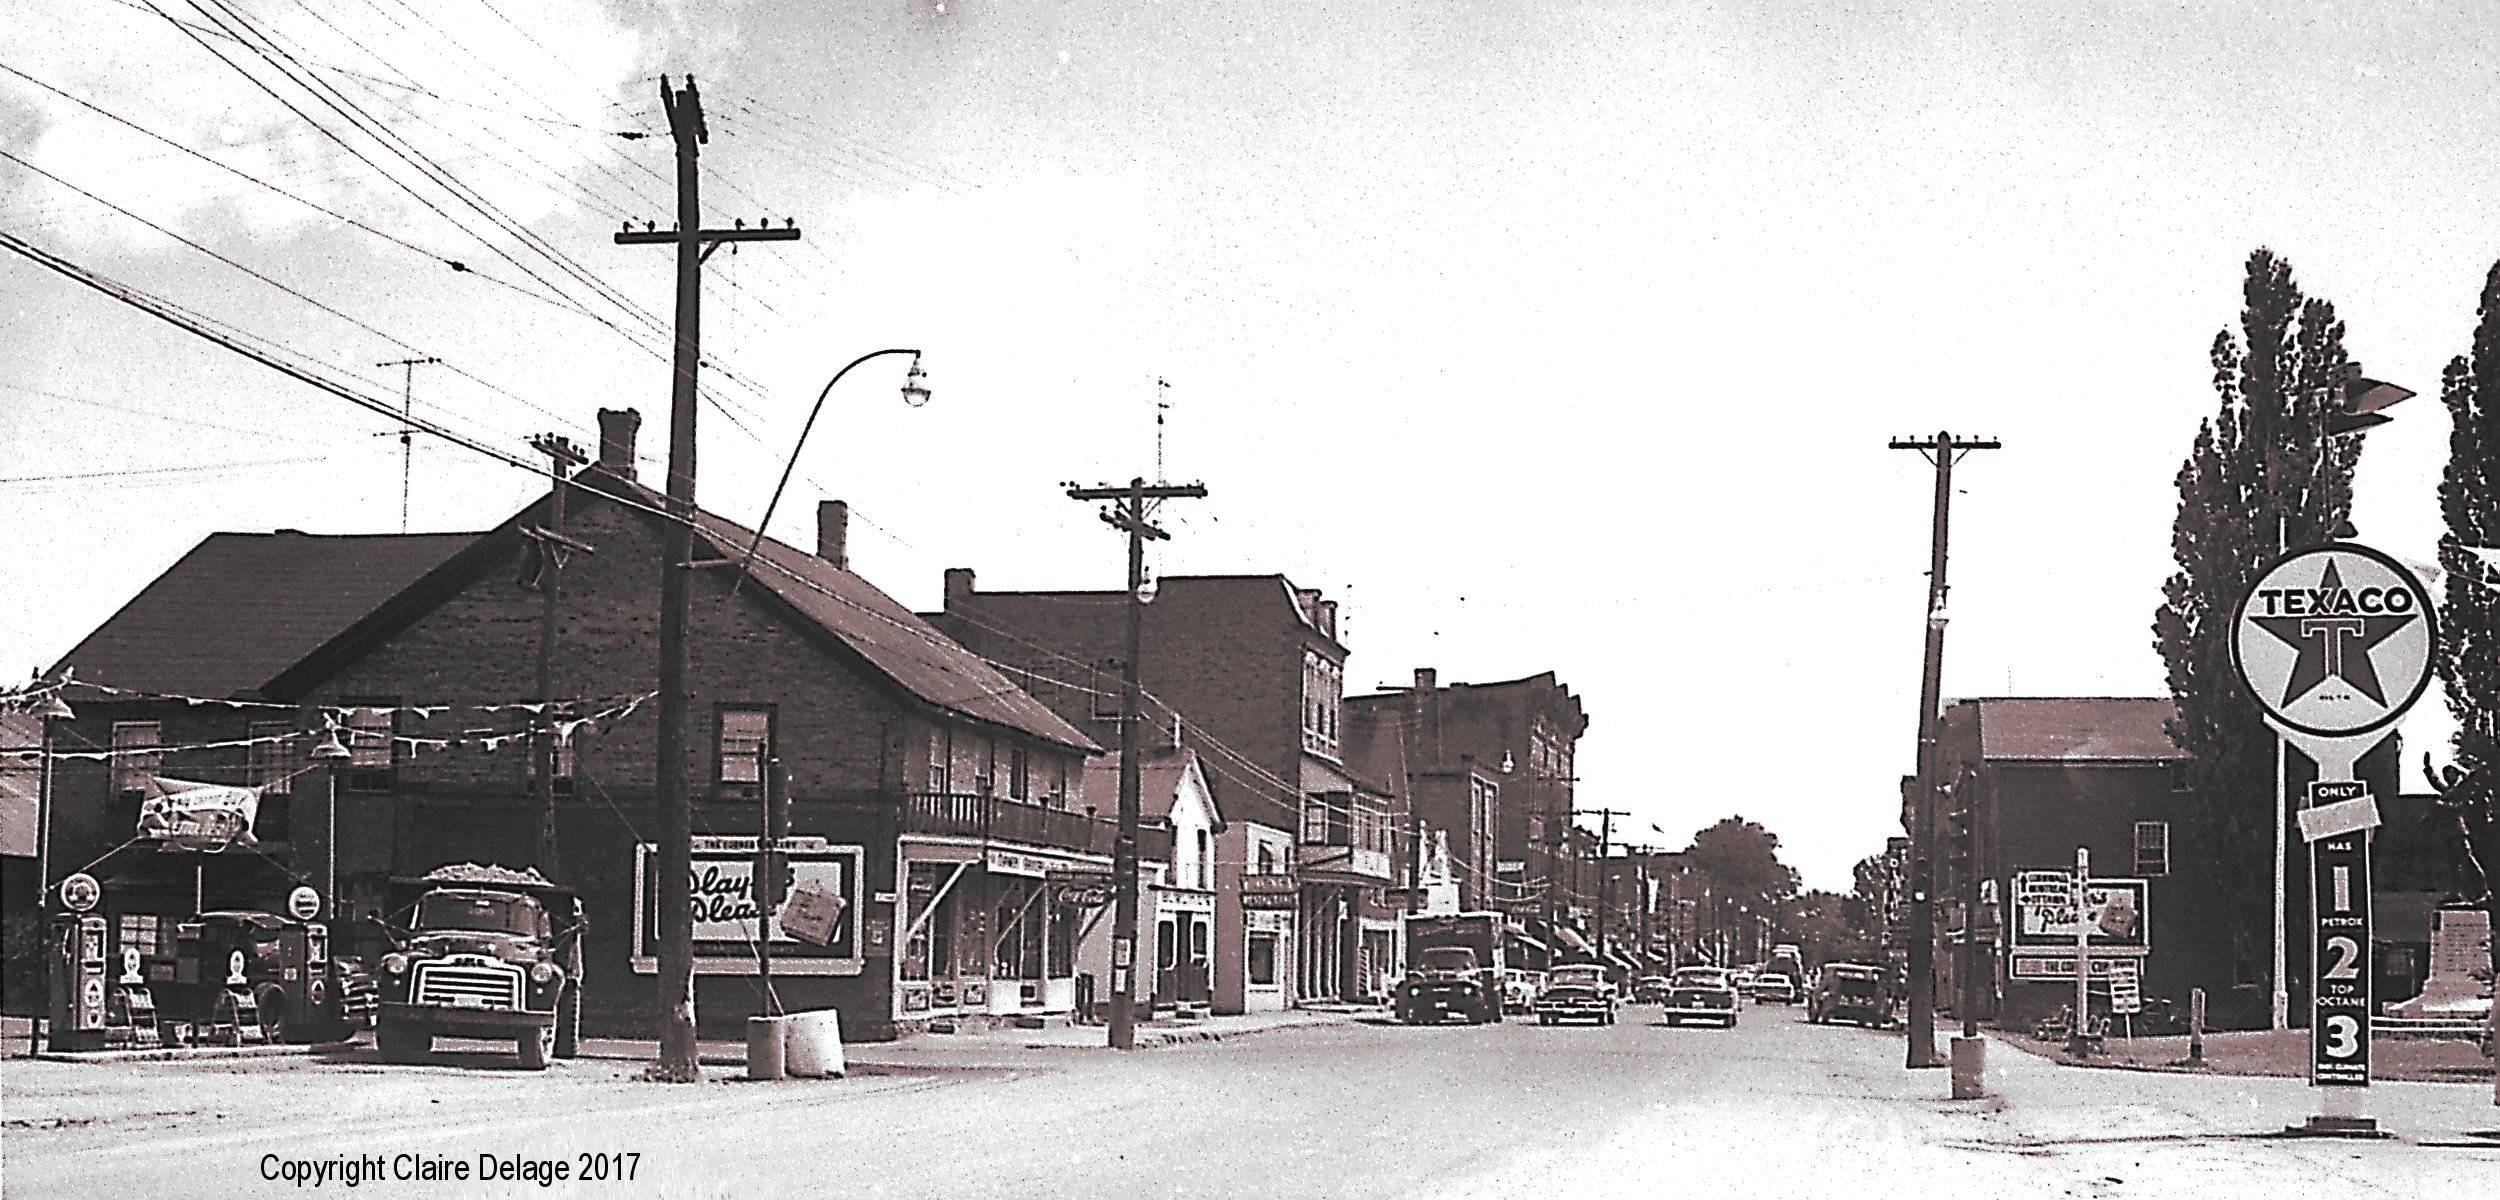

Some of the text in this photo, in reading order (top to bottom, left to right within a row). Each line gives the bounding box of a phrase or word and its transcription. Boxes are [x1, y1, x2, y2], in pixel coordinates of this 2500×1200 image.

[2258, 587, 2413, 615] TEXACO
[2302, 618, 2365, 677] T
[2318, 786, 2356, 797] ONLY
[2327, 842, 2352, 850] HAS
[2333, 866, 2350, 912] 1
[2321, 917, 2363, 927] PETROX
[2323, 936, 2360, 979] 2
[2331, 984, 2355, 995] TOP
[2317, 997, 2365, 1007] OCTANE
[2326, 1014, 2360, 1058] 3
